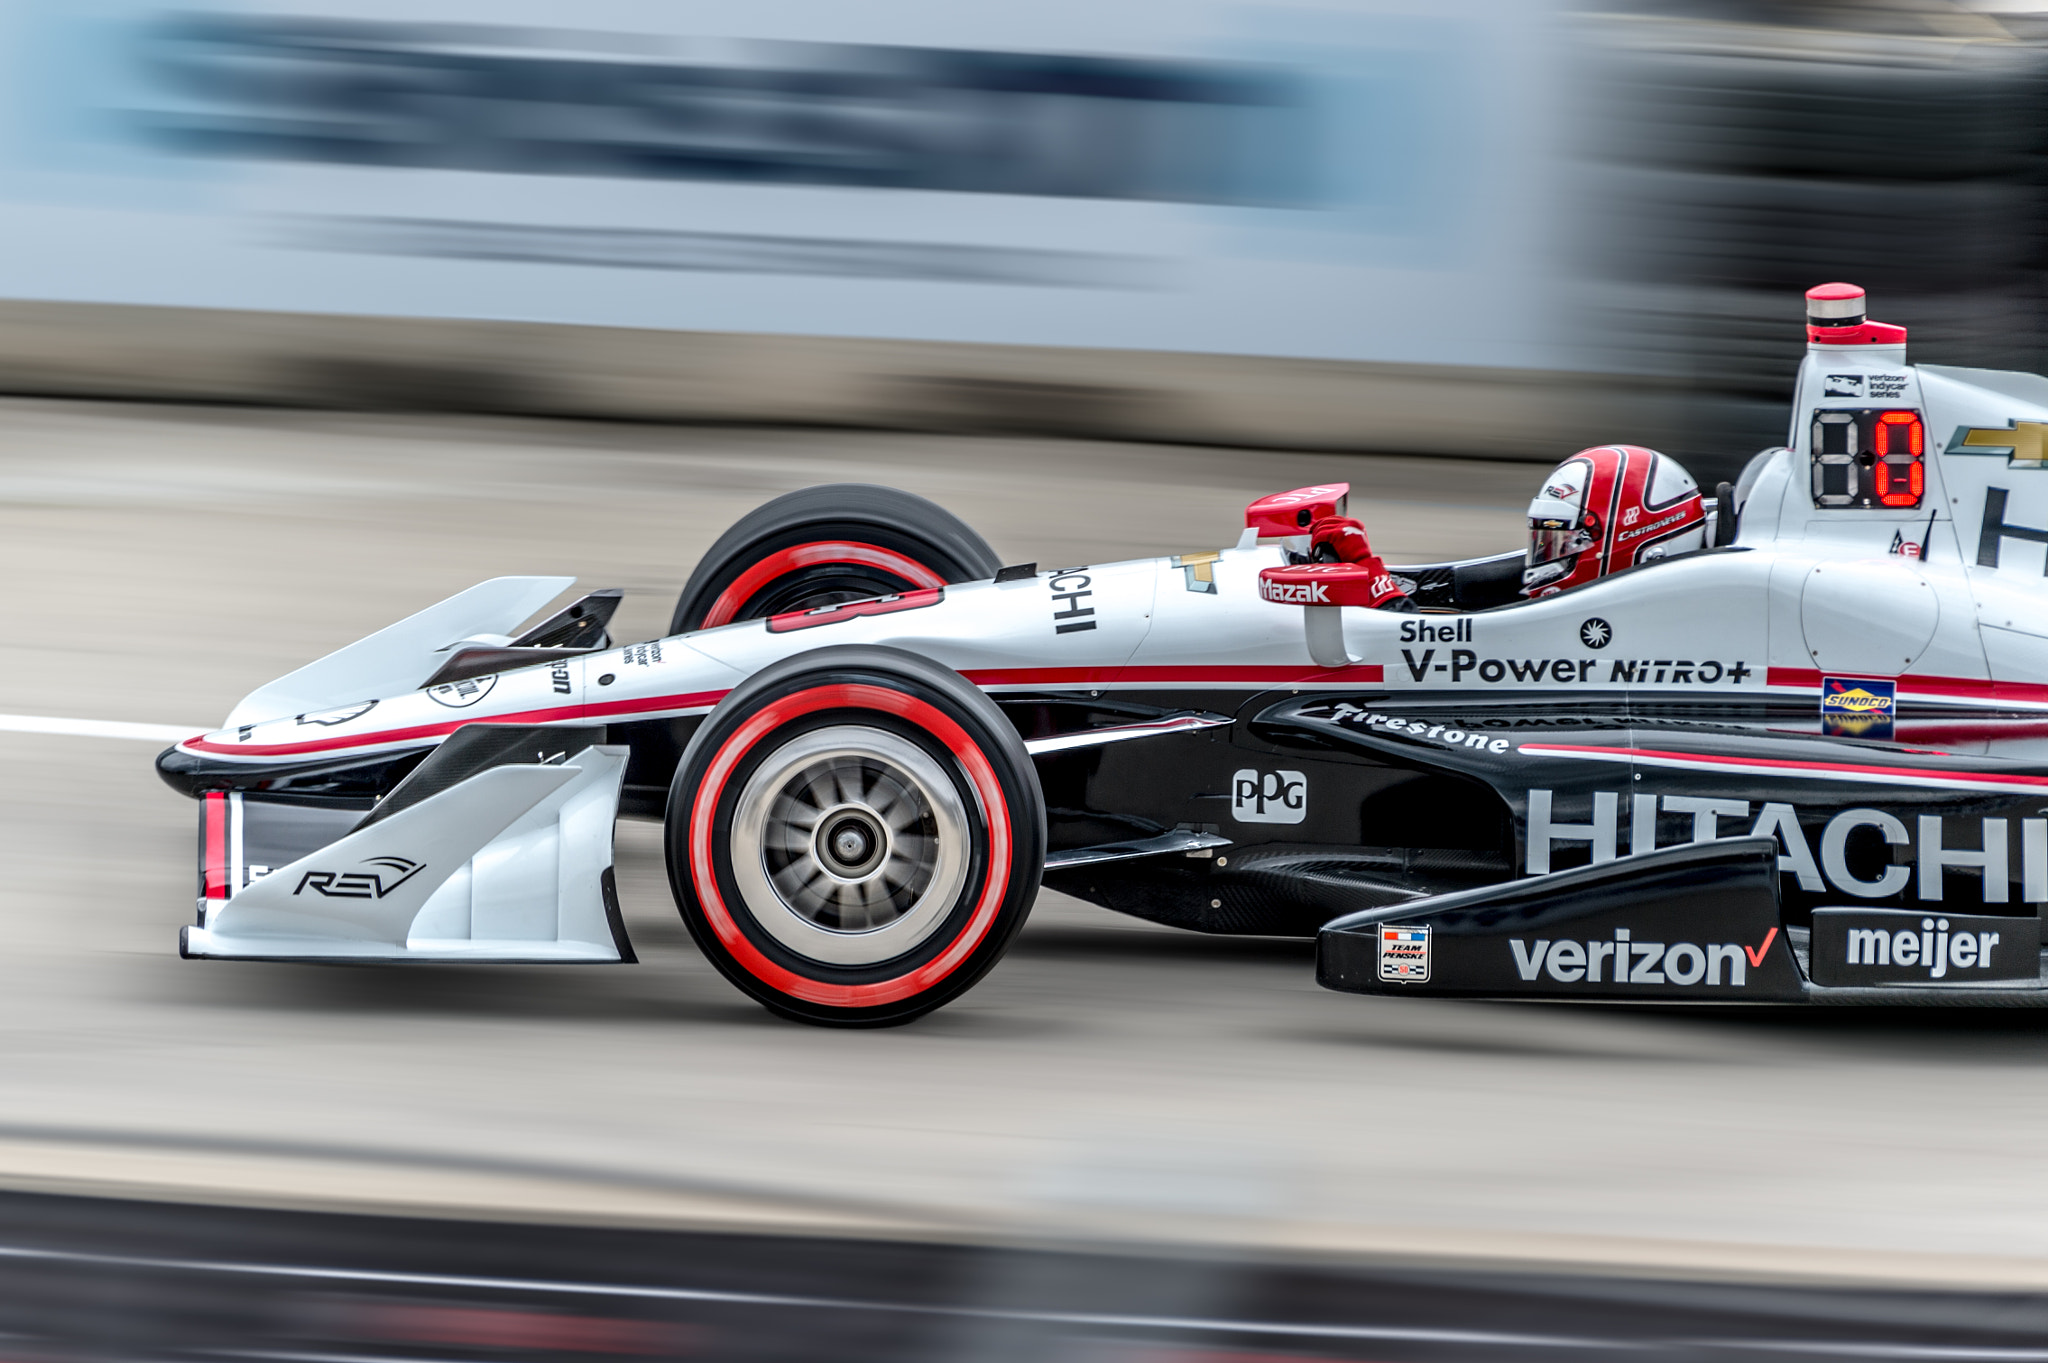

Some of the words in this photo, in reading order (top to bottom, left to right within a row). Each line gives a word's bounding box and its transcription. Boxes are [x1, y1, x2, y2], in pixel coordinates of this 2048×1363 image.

[1869, 382, 1908, 392] indycar
[1259, 577, 1331, 603] Mazak
[1400, 618, 1473, 643] Shell
[1401, 649, 1597, 683] V-Power
[1827, 695, 1891, 708] SUNOCO
[1330, 702, 1511, 755] Firestone
[1235, 770, 1304, 815] PPG
[1525, 788, 2048, 904] HITACHI
[292, 862, 427, 900] REV
[1382, 952, 1425, 960] PENSKE
[1391, 944, 1423, 952] TEAM
[1509, 928, 1747, 987] verizon
[1846, 918, 2000, 978] meijer
